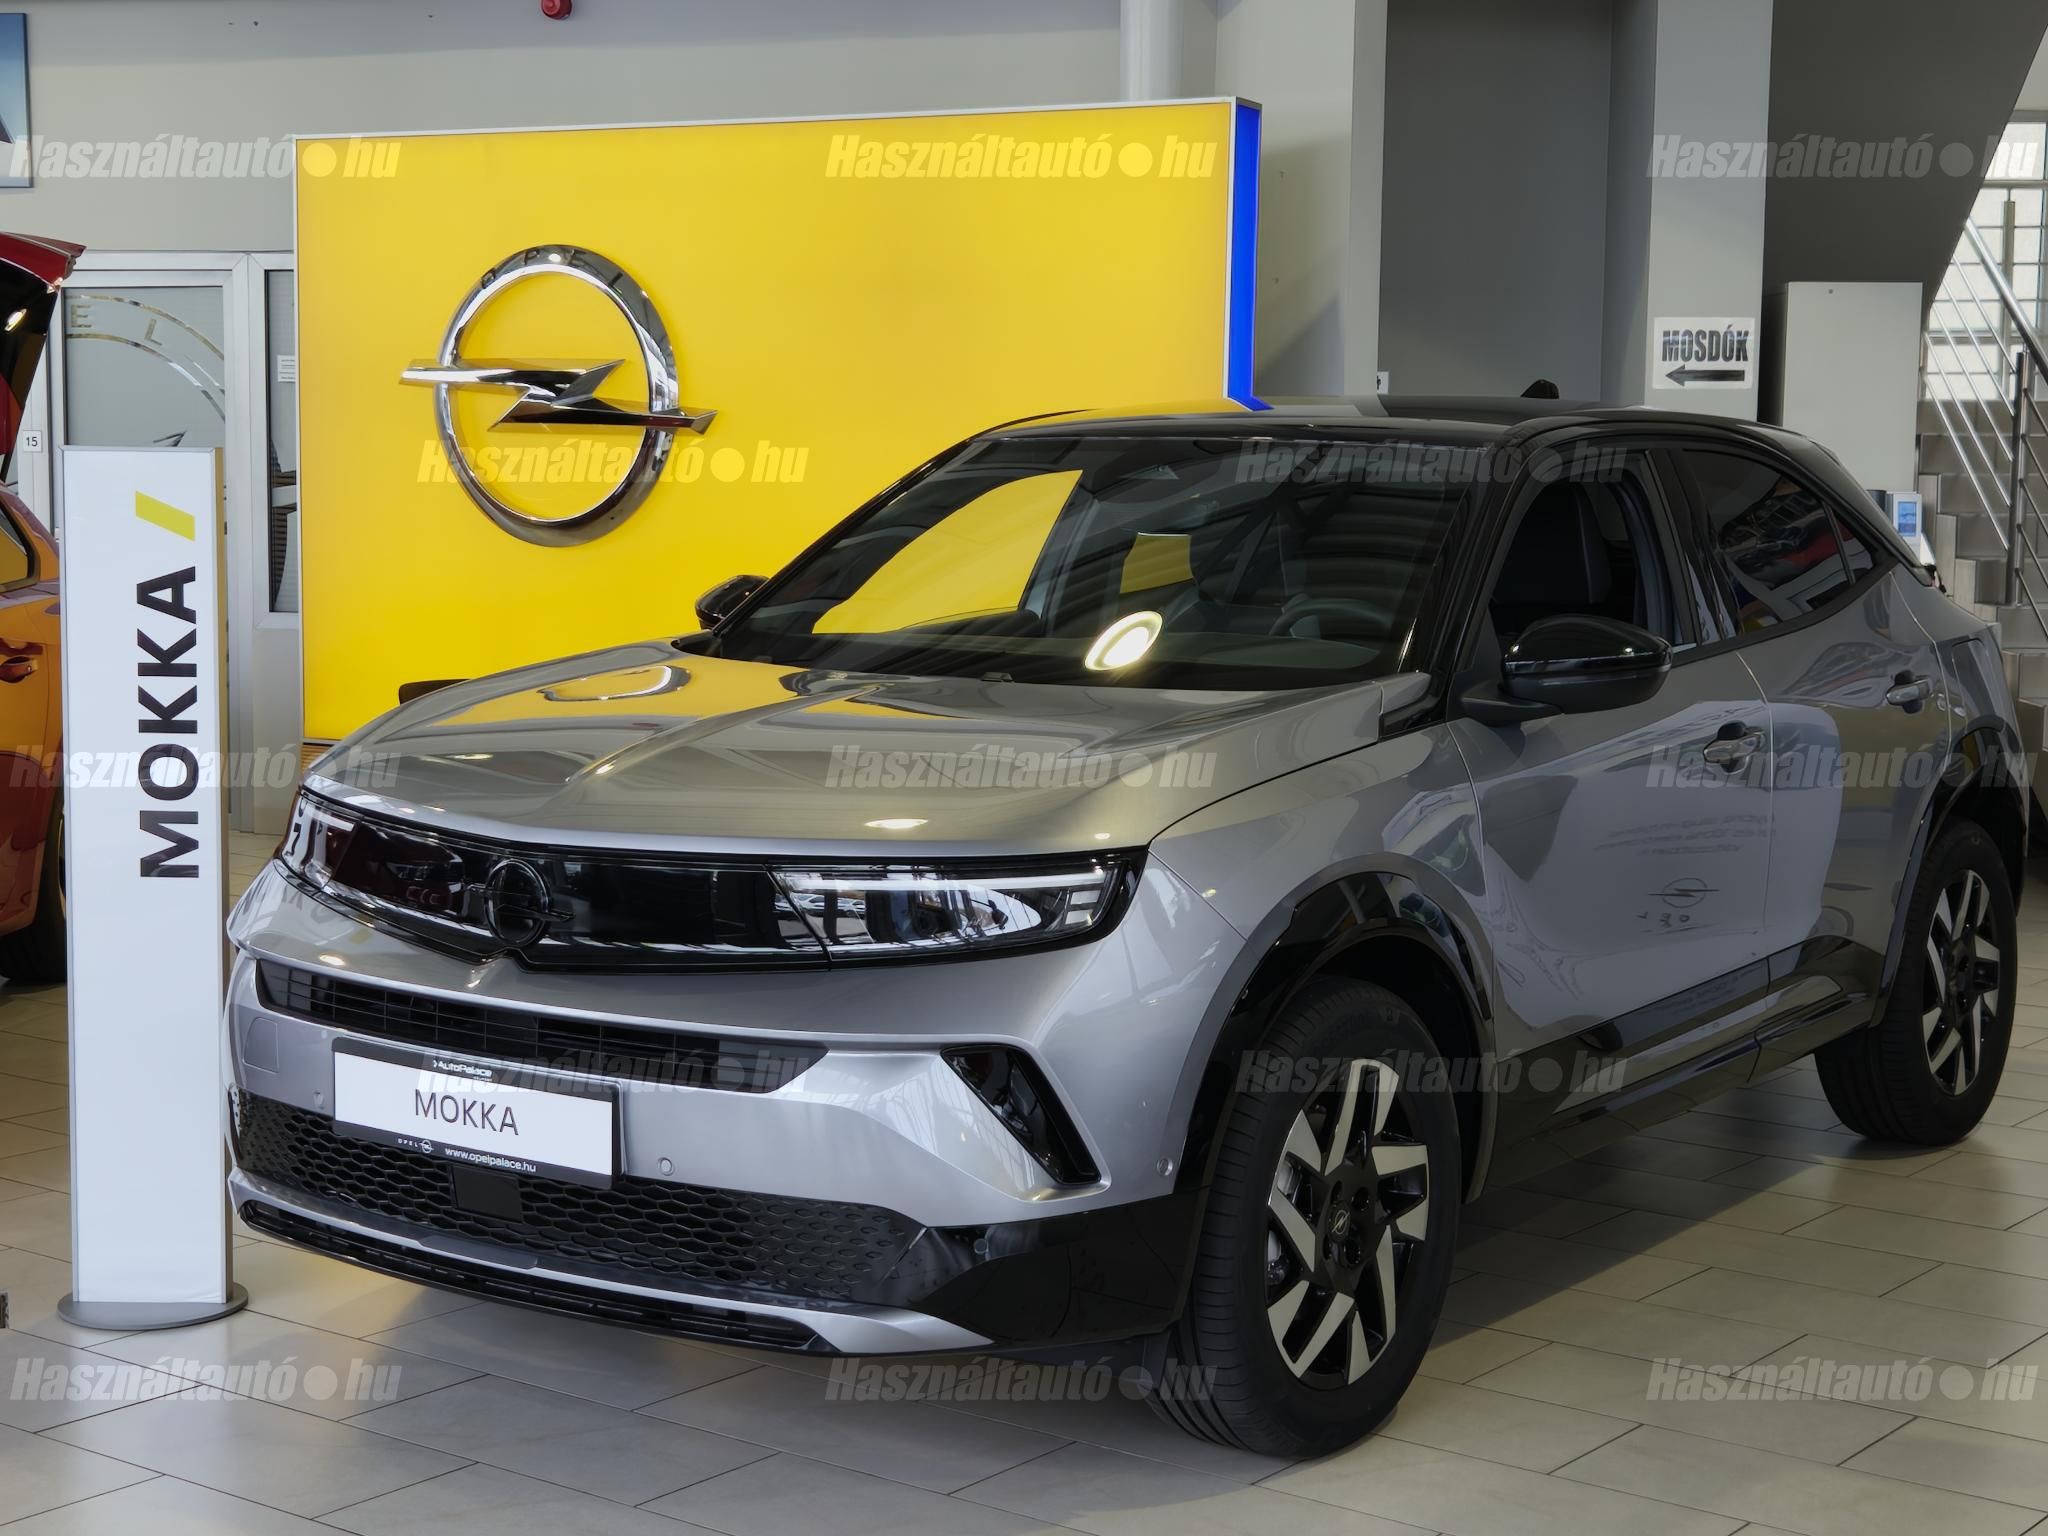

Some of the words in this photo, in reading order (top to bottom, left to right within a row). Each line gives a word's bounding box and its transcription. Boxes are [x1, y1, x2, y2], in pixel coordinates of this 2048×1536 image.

[1662, 323, 1749, 362] MOSDÓK
[26, 436, 38, 447] 15
[137, 566, 199, 878] MOKKA
[415, 1088, 519, 1136] MOKKA
[397, 1138, 418, 1148] OPEL
[444, 1147, 537, 1173] www.opelpalace.hu
